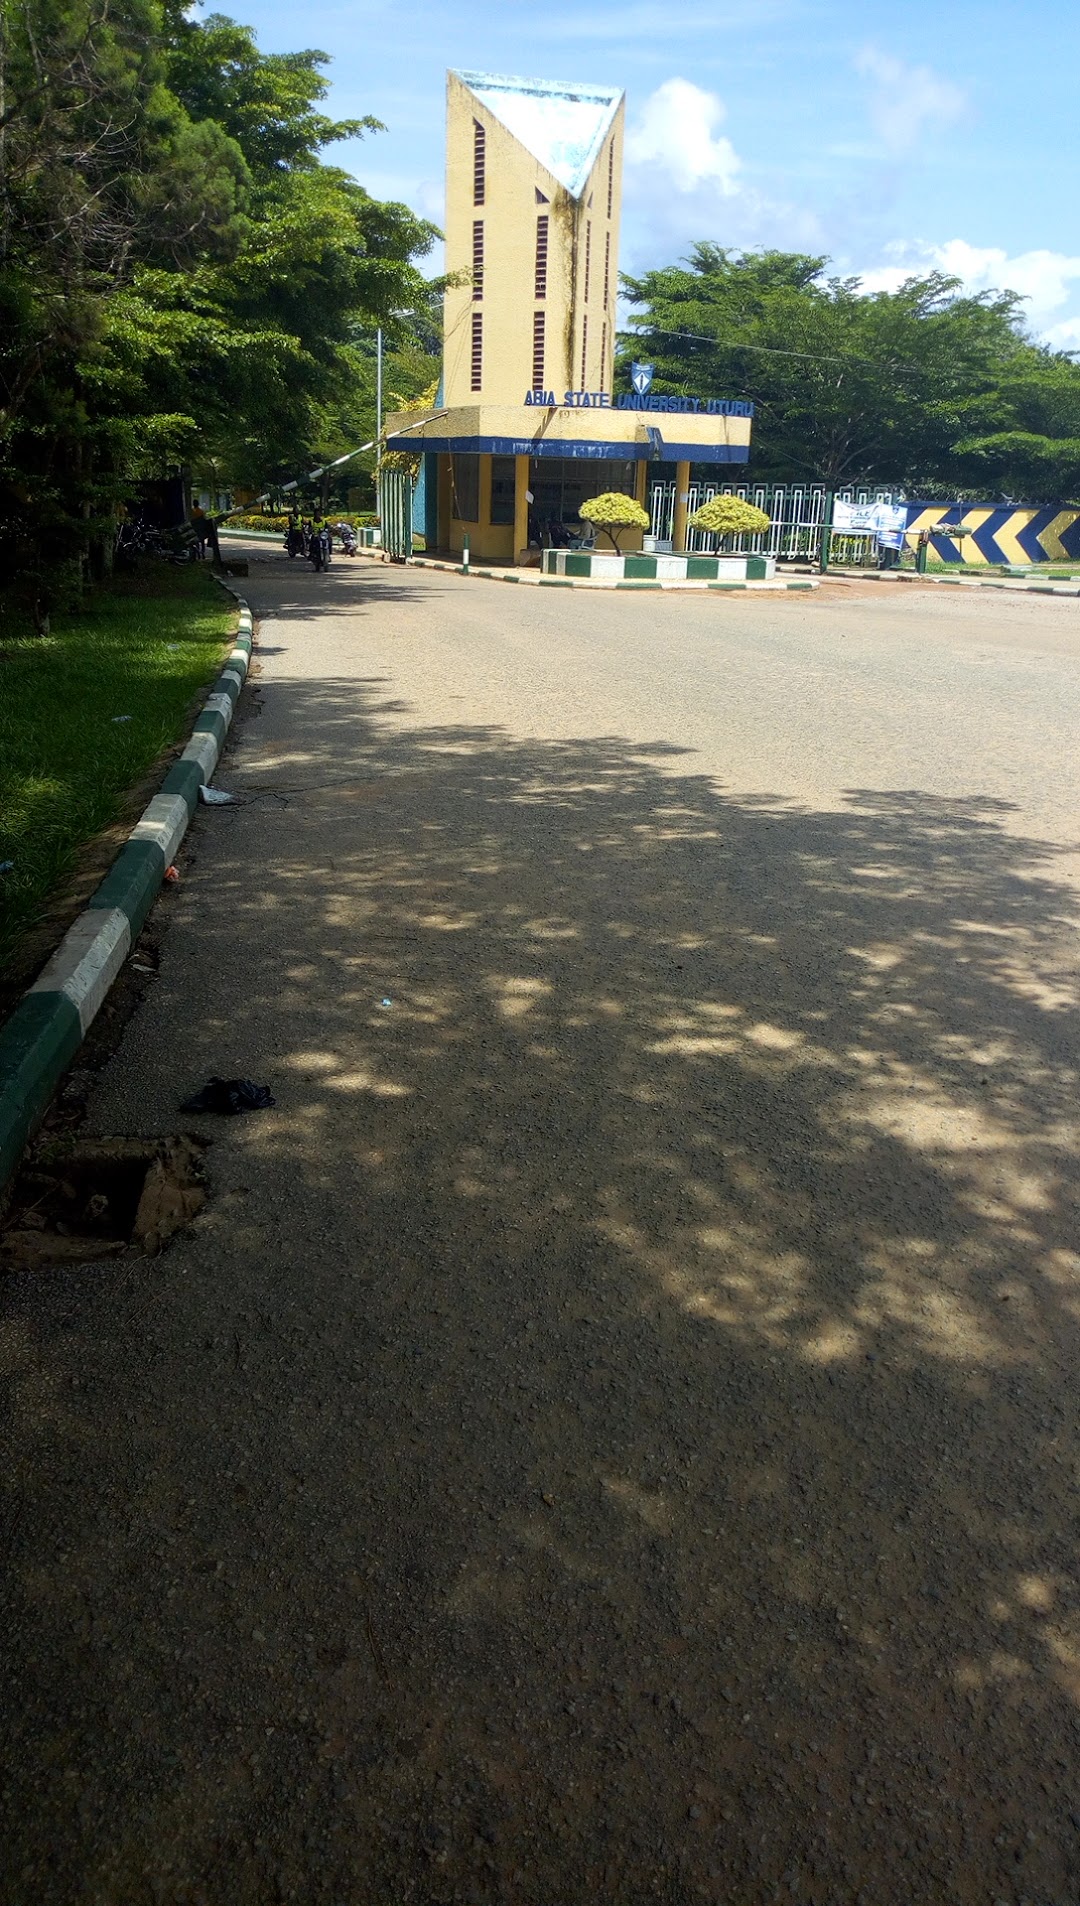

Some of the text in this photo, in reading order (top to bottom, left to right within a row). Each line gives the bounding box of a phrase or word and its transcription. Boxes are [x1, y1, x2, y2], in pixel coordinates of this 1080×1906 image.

[524, 390, 755, 418] ABIA STATE UNIVERSITY UTURU
